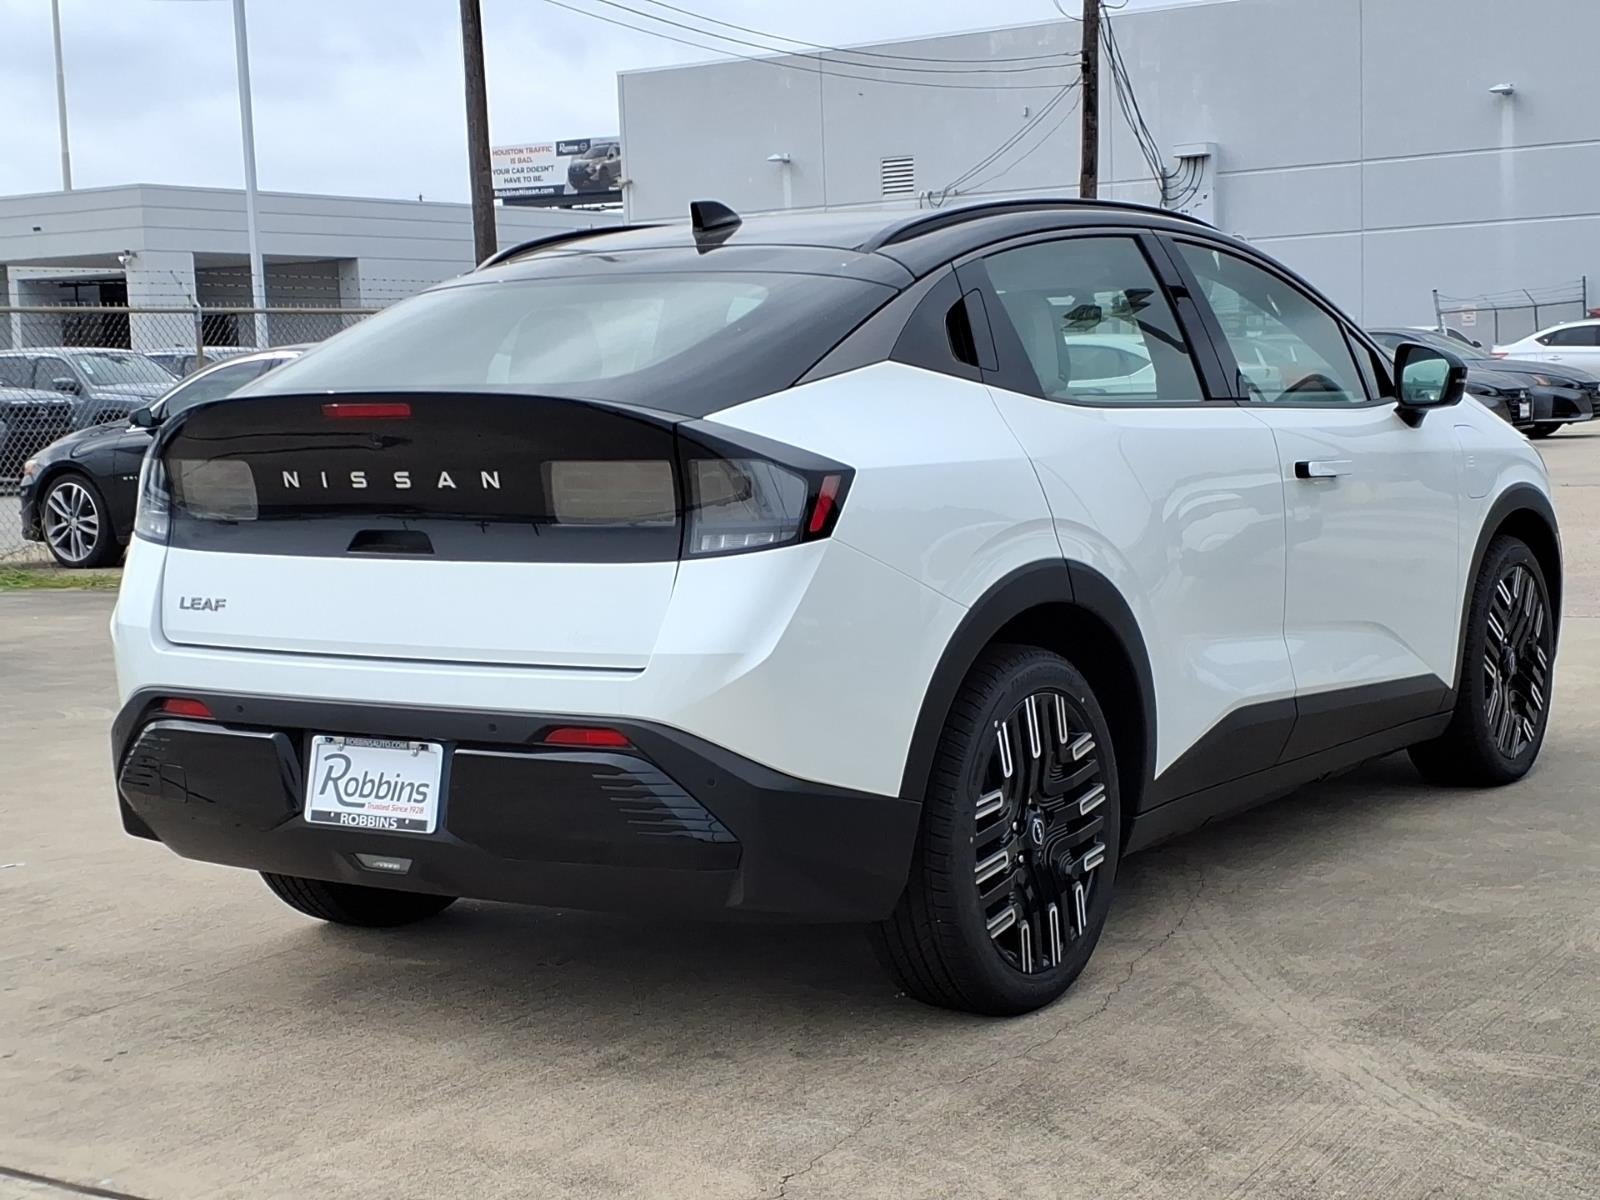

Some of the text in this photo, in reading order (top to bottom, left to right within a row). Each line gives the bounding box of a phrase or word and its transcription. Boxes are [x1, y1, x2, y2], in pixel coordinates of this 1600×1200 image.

[493, 147, 524, 156] HOUSTON
[525, 146, 552, 154] TRAFFIC
[526, 165, 554, 173] DOESN'T
[282, 471, 500, 489] NISSAN
[179, 596, 226, 611] LEAF
[319, 753, 430, 808] Robbins
[391, 804, 408, 813] Since
[340, 812, 398, 829] ROBBINS
